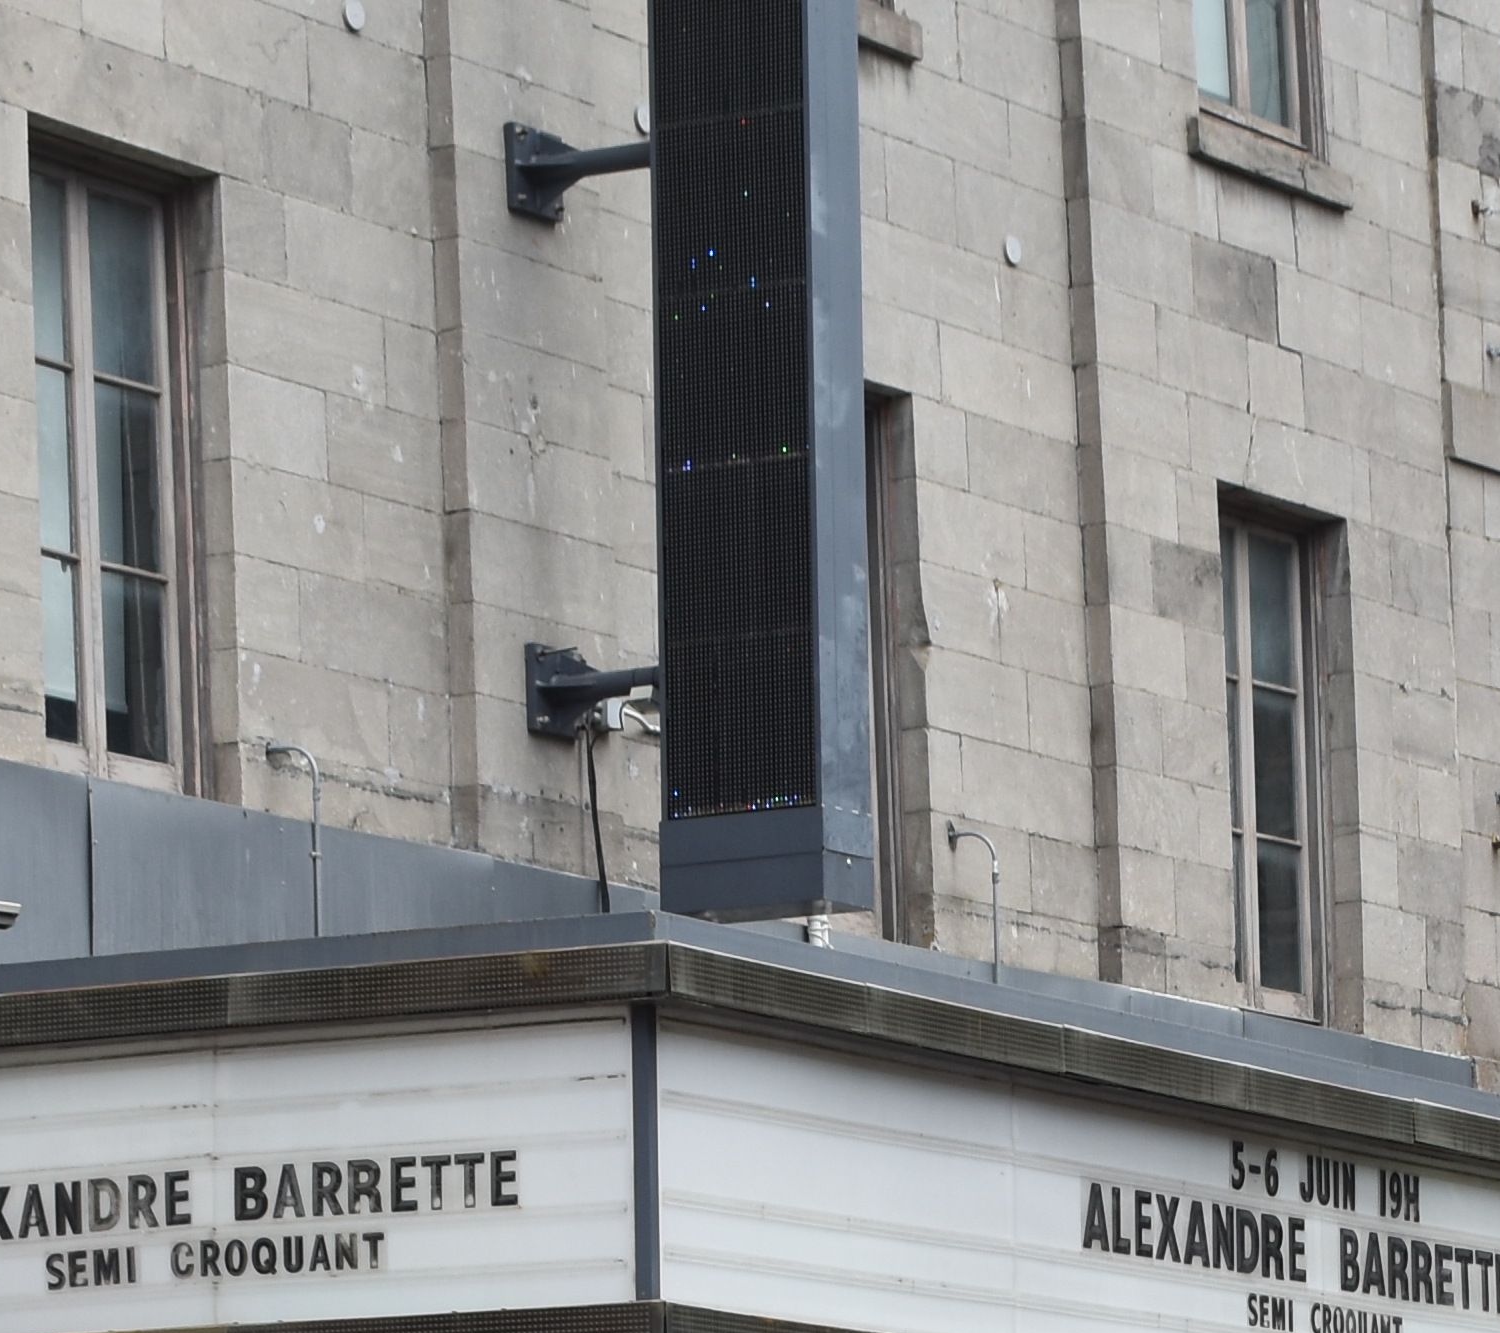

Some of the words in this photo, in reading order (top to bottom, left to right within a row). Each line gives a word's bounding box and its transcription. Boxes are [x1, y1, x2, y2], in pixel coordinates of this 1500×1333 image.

[234, 1150, 519, 1222] BARRETTE
[1231, 1140, 1279, 1198] 5-6
[1301, 1154, 1356, 1212] JUIN
[1379, 1169, 1421, 1223] 19H
[45, 1246, 138, 1291] SEMI
[170, 1232, 386, 1280] CROQUANT
[1083, 1182, 1307, 1283] ALEXANDRE
[1247, 1293, 1295, 1333] SEMI
